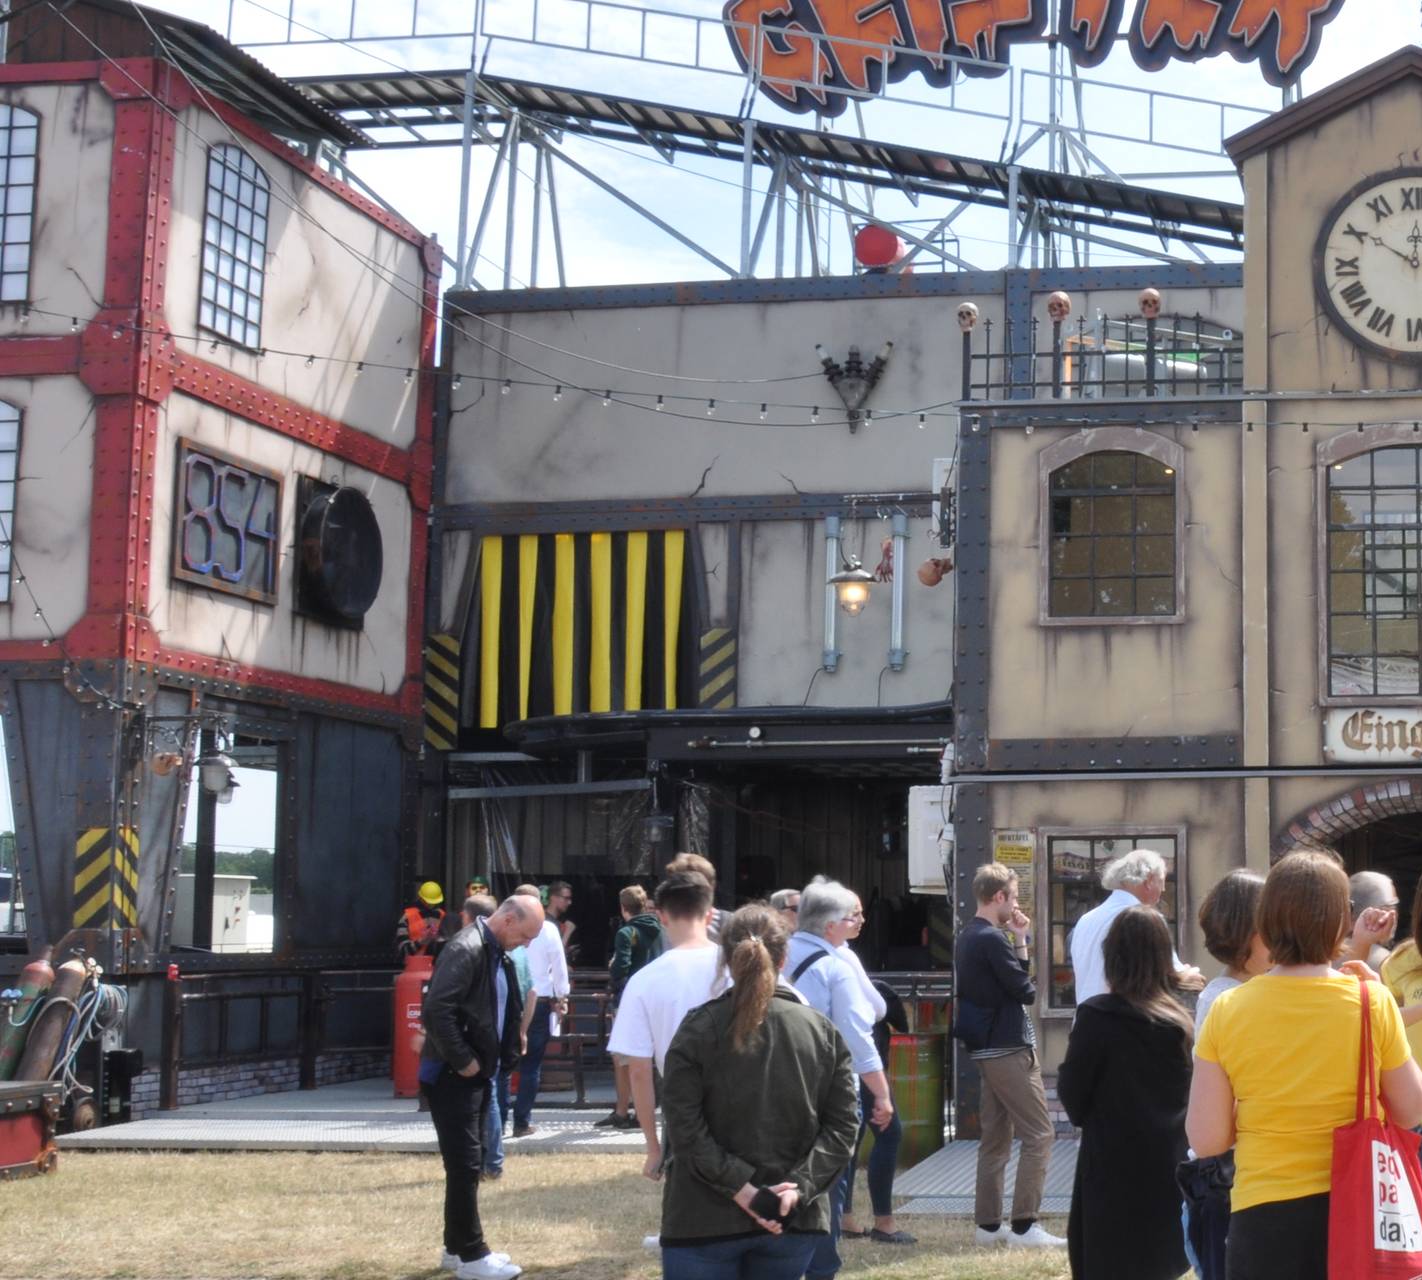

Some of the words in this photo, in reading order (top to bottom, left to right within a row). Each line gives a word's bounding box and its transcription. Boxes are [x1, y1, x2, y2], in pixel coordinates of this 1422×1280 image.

[1366, 194, 1393, 223] XI
[1342, 223, 1368, 244] X
[1335, 256, 1359, 276] IX
[1340, 280, 1373, 317] VIII
[1366, 306, 1395, 338] VII
[183, 452, 276, 593] 854
